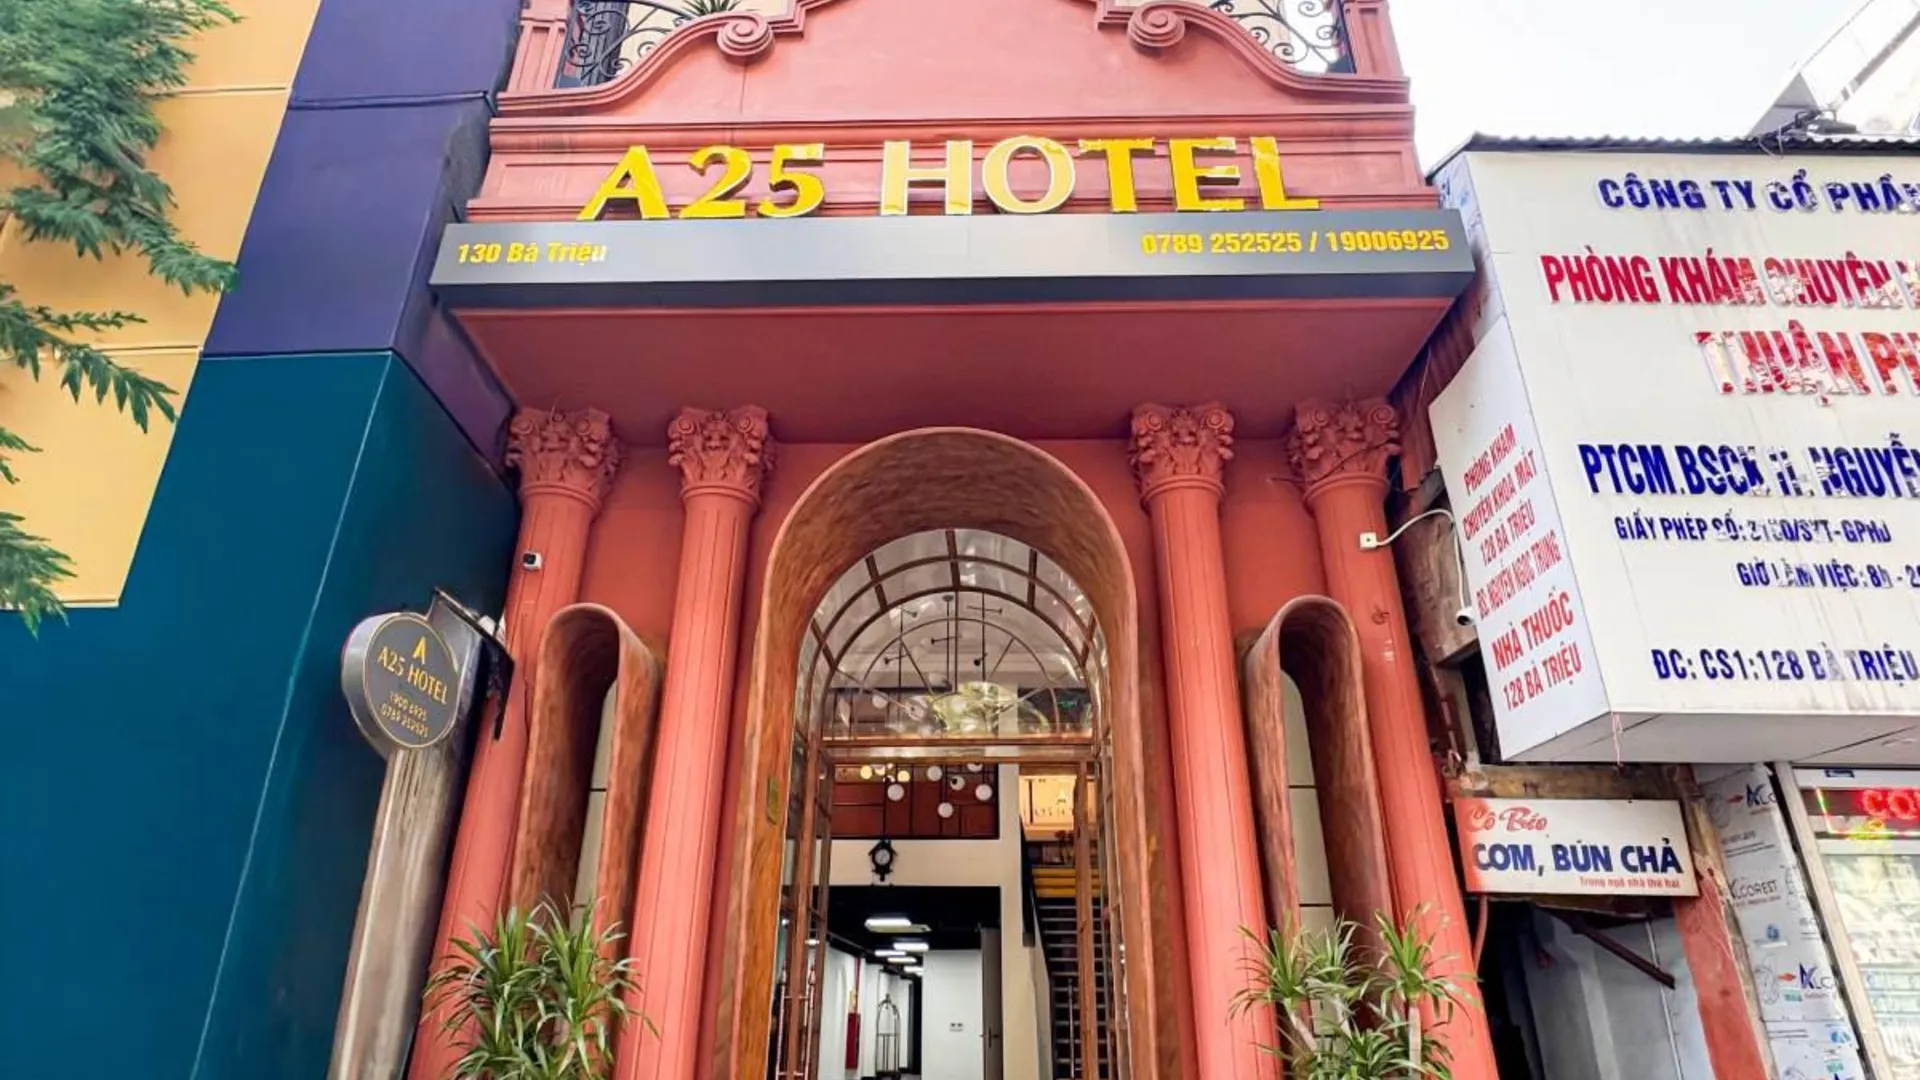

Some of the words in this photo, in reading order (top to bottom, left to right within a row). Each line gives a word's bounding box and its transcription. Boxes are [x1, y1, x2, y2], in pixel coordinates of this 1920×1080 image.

[577, 142, 825, 221] A25
[879, 135, 1320, 215] HOTEL
[1598, 171, 1705, 210] CÔNG
[1711, 178, 1757, 211] TY
[1763, 168, 1819, 212] CỔ
[458, 242, 502, 263] 130
[547, 241, 608, 267] Triệu
[1141, 232, 1203, 255] 0789
[1210, 231, 1302, 254] 252525
[1309, 230, 1318, 253] /
[1325, 229, 1450, 252] 19006925
[1540, 244, 1661, 304] PHÒNG
[1657, 247, 1766, 306] KHÁM
[1613, 506, 1657, 541] GIẤY
[1659, 511, 1709, 541] PHÉP
[1480, 532, 1498, 567] 128
[1491, 620, 1524, 672] NHÀ
[1521, 585, 1575, 651] THUỐC
[376, 645, 405, 678] A25
[407, 664, 448, 704] HOTEL
[1502, 677, 1526, 712] 128
[1523, 659, 1545, 700] BÀ
[1541, 640, 1583, 688] TRIỆU
[1842, 642, 1920, 688] TRIỆU
[1551, 839, 1614, 873] BÚN
[1620, 836, 1684, 874] CHẢ
